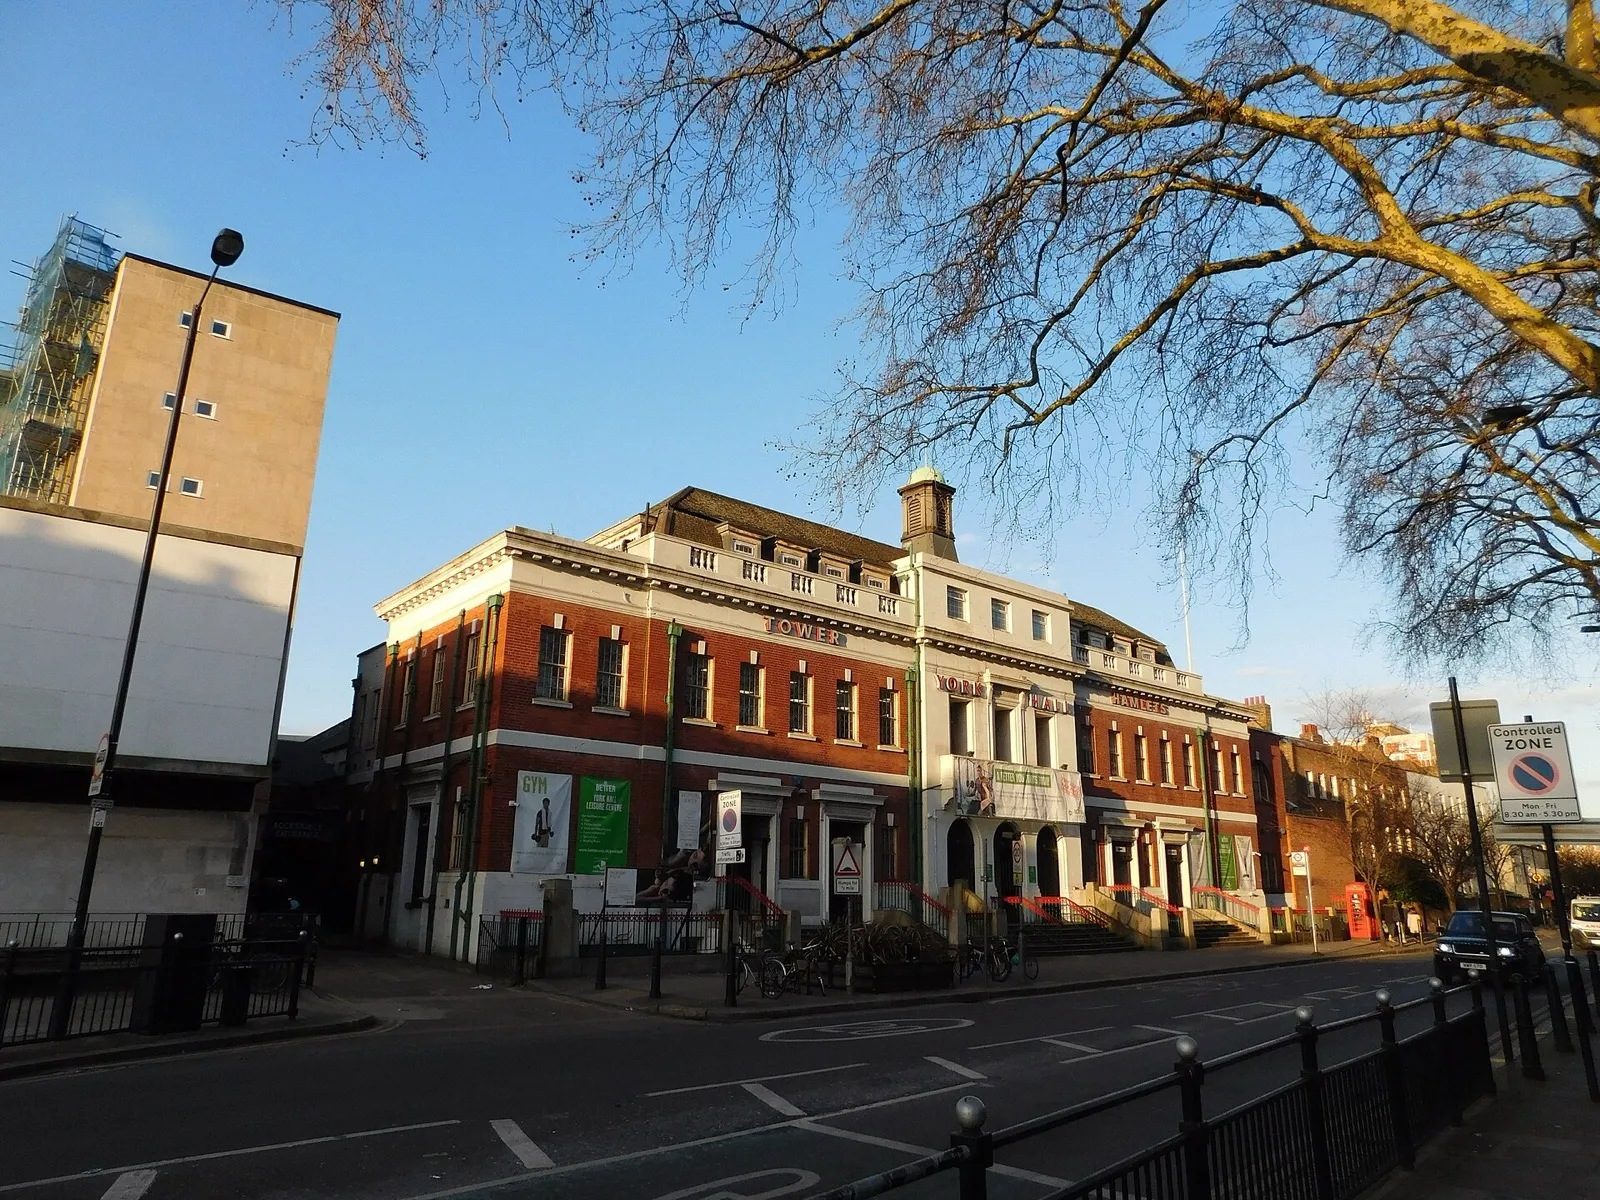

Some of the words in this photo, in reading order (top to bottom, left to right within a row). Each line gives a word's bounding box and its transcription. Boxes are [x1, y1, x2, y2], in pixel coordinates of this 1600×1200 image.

[763, 614, 841, 645] TOWER
[936, 674, 983, 697] YORK
[1110, 692, 1169, 715] HAMLETS
[1493, 725, 1562, 738] Controlled
[1505, 738, 1553, 751] ZONE
[523, 775, 548, 795] GYM
[595, 783, 616, 793] BETTER
[722, 800, 737, 809] ZONE
